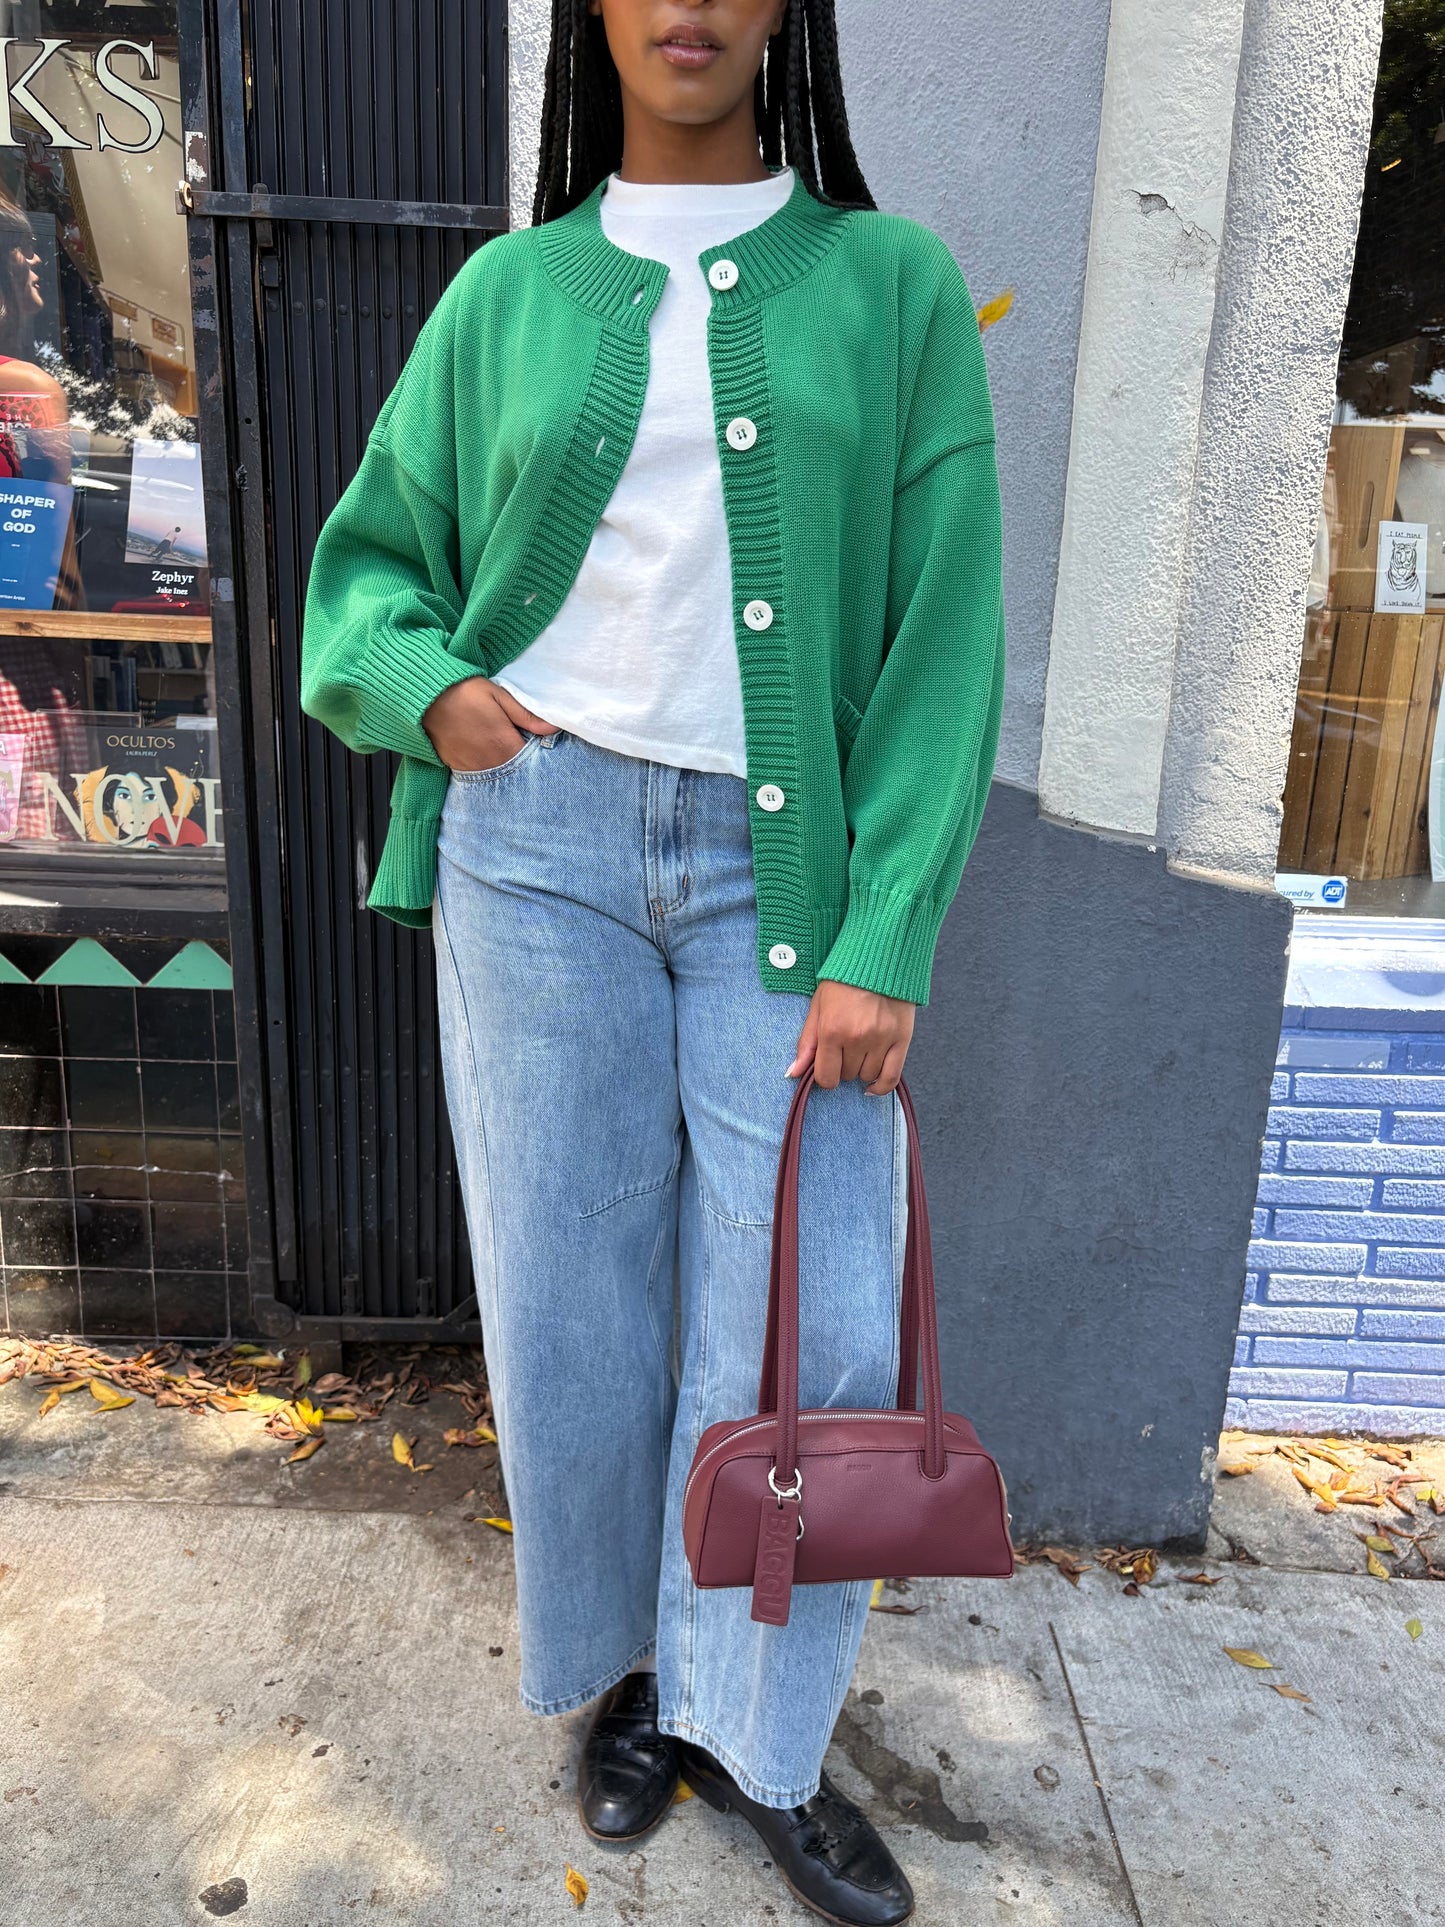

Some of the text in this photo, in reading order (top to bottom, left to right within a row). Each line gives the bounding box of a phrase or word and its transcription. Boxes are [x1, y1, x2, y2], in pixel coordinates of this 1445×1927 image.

[11, 508, 32, 519] OF
[3, 521, 36, 534] GOD
[152, 570, 194, 585] Zephyr
[156, 586, 189, 595] Jake Inez
[106, 735, 176, 749] OCULTOS
[1303, 890, 1315, 899] by
[1325, 886, 1343, 897] ADT
[757, 1515, 790, 1621] BAGGU
